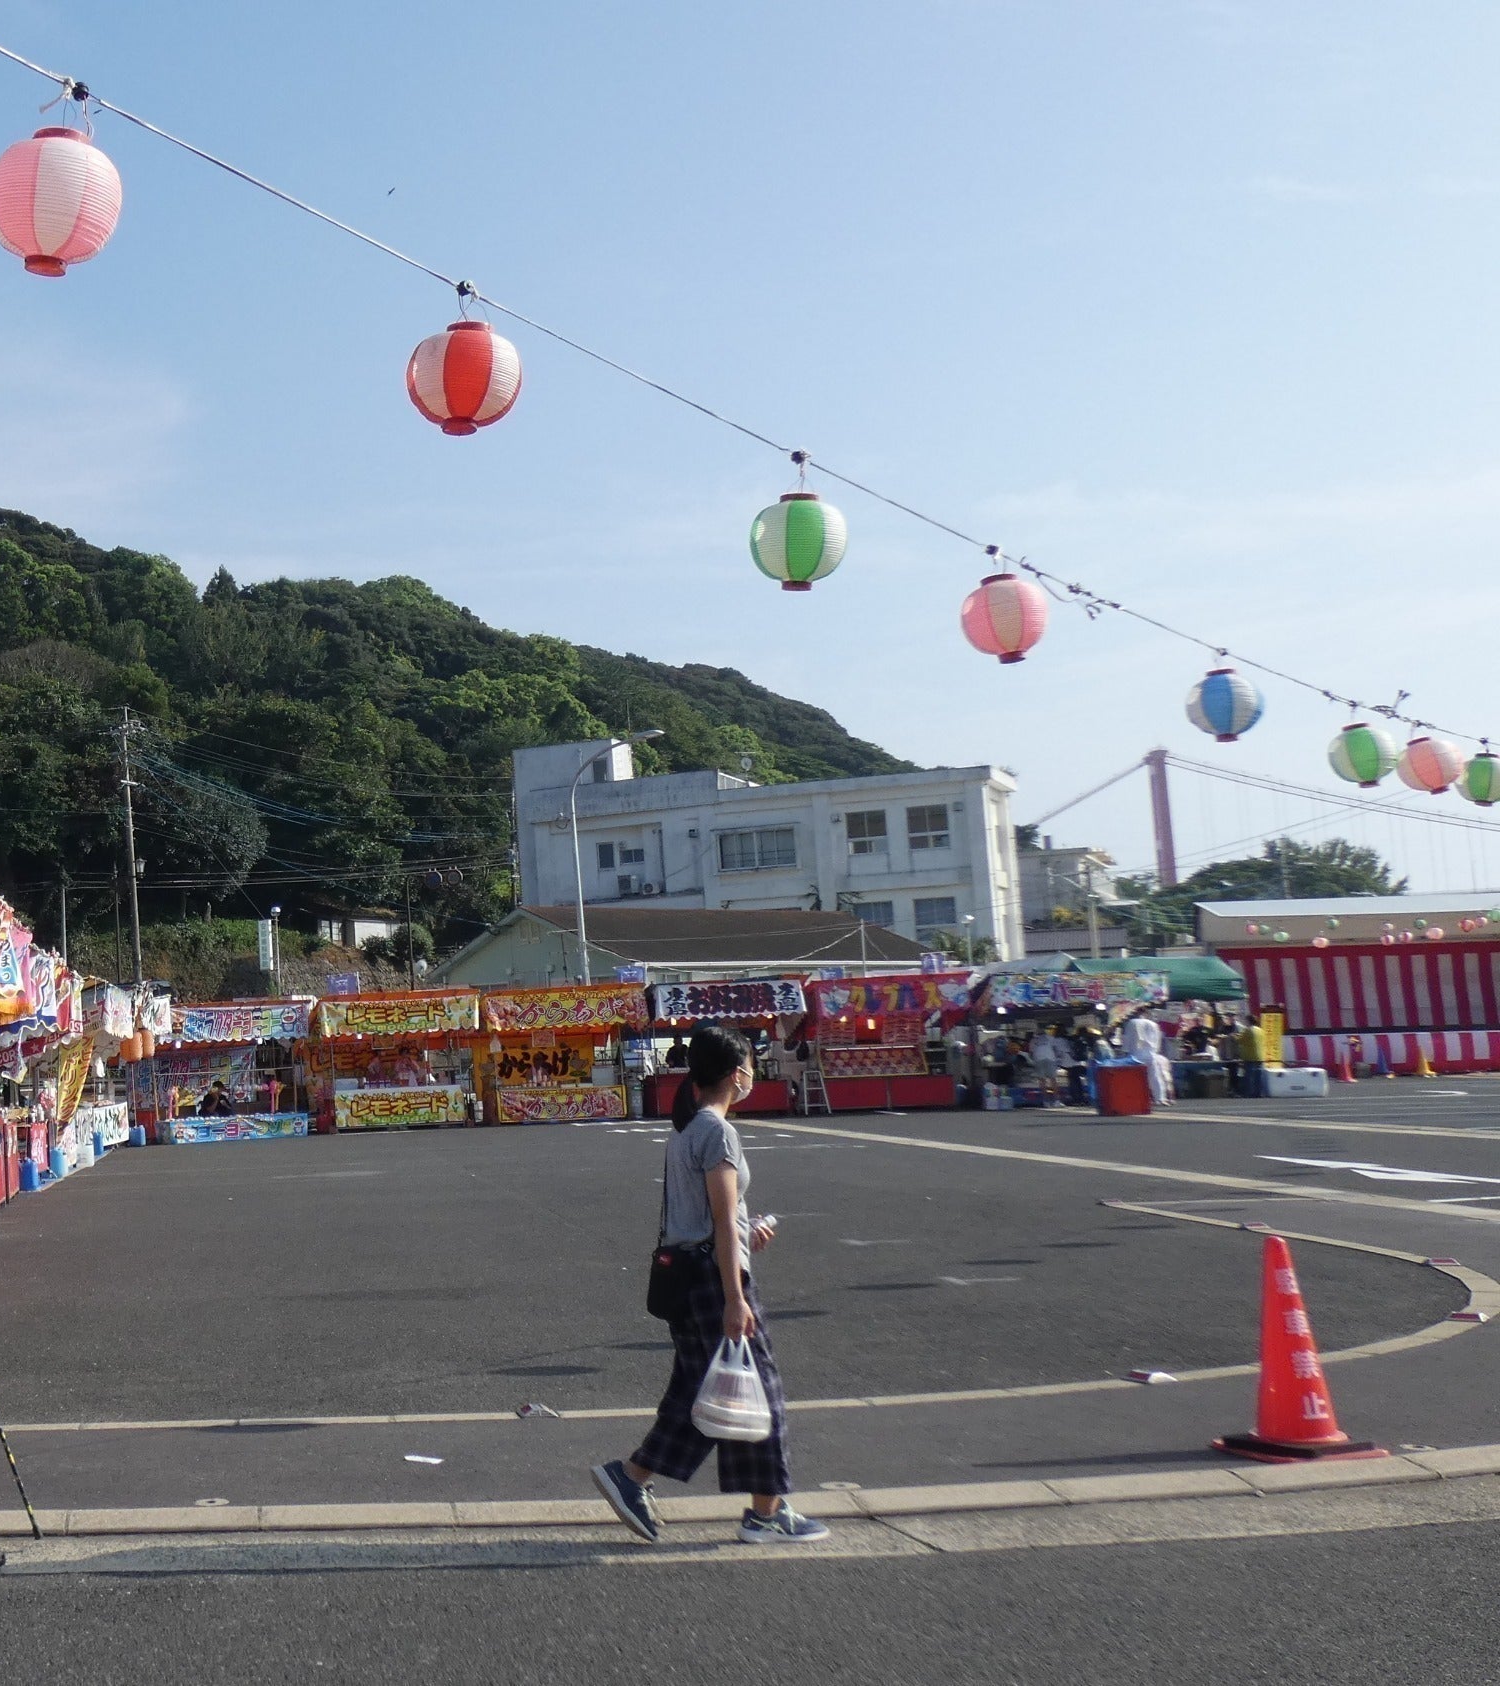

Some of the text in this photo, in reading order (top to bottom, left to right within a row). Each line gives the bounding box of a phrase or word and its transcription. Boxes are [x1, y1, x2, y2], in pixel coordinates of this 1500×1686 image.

[184, 1009, 283, 1039] キャラクターヨーヨー
[346, 1005, 446, 1026] レモネード
[357, 1018, 438, 1033] Lemonade
[517, 999, 625, 1028] からあげ
[498, 1048, 573, 1080] からあげ
[350, 1096, 449, 1118] レモネード
[361, 1111, 441, 1124] Lemonade
[526, 1094, 598, 1119] からあげ
[1273, 1268, 1330, 1420] 駐車禁止
